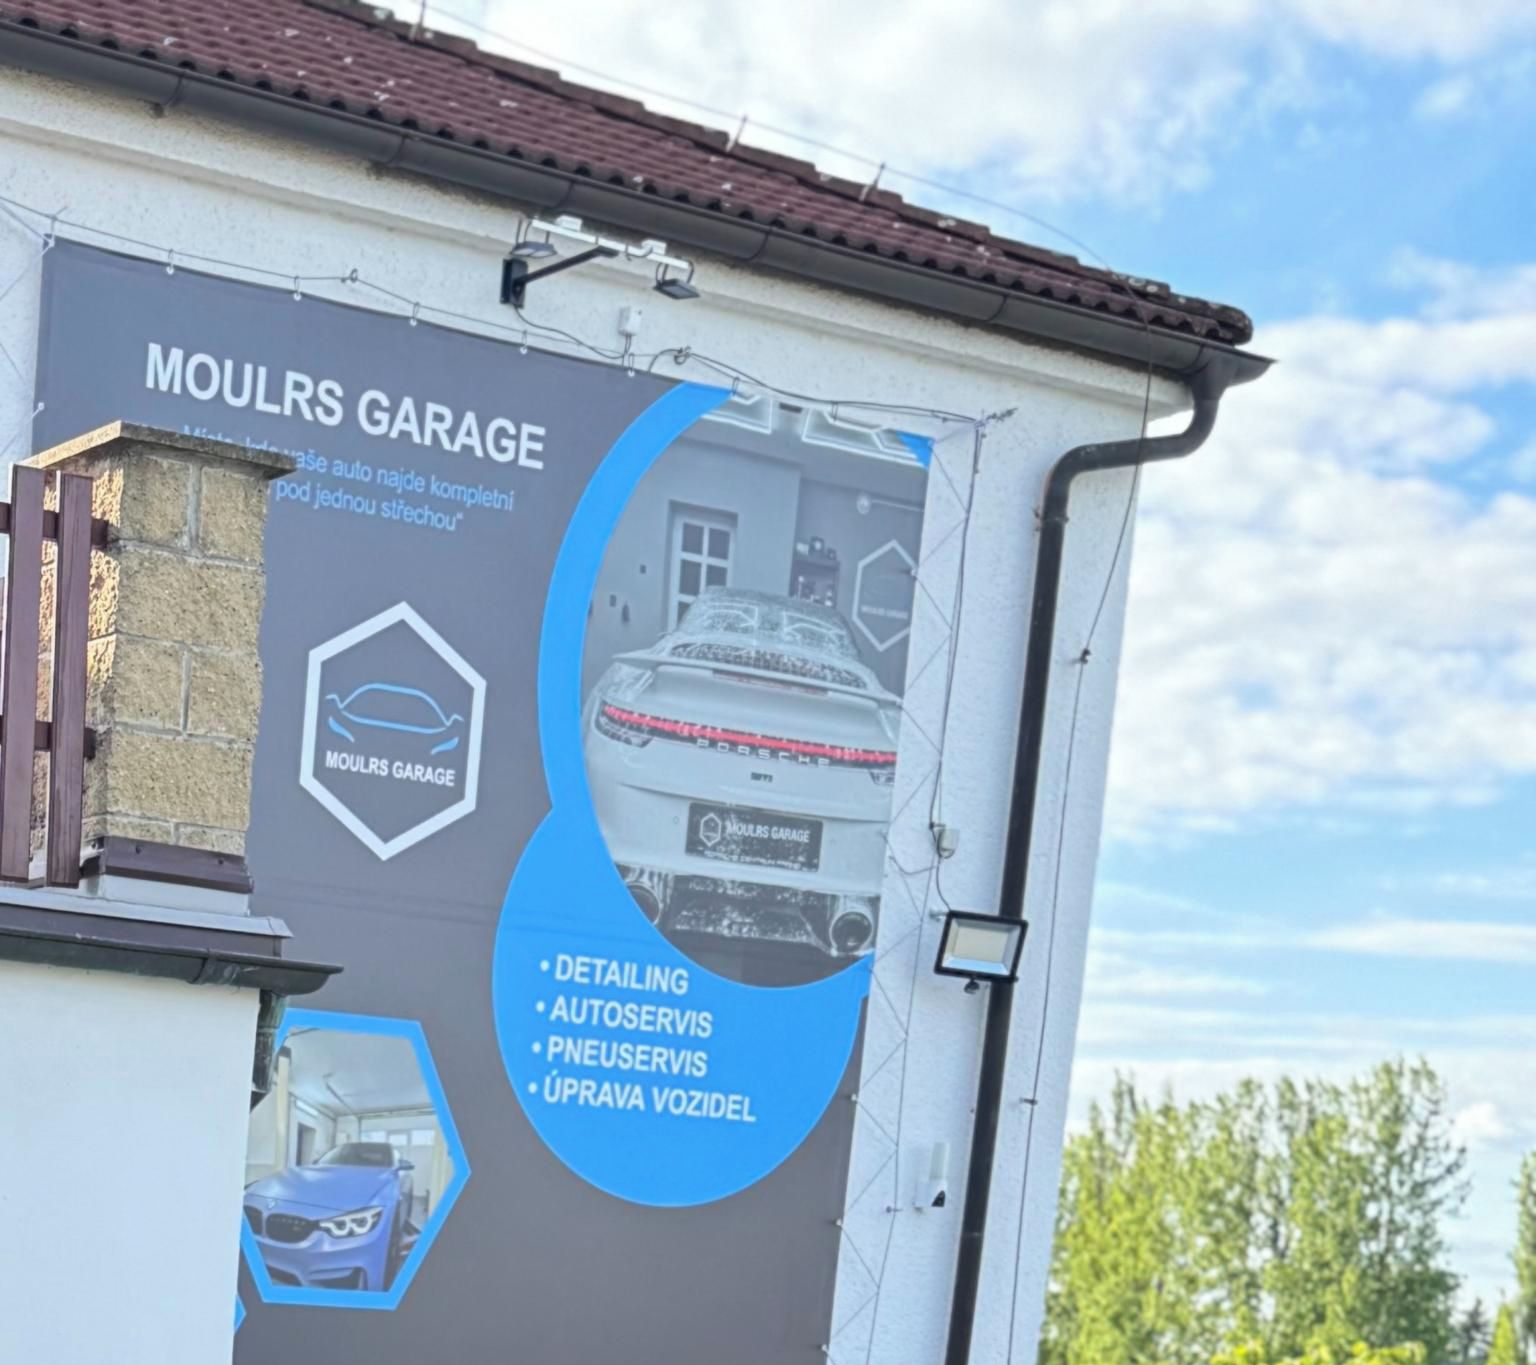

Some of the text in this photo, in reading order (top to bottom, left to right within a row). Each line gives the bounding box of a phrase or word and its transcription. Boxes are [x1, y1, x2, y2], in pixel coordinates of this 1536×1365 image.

[145, 342, 546, 470] MOULRS GARAGE
[275, 478, 310, 502] pod
[313, 483, 376, 516] jednou
[332, 459, 372, 483] auto
[376, 469, 426, 494] najde
[430, 476, 515, 512] kompletní
[325, 750, 456, 787] MOULRS GARAGE
[726, 820, 811, 843] MOULRS GARAGE
[554, 953, 690, 996] DETAILING
[549, 995, 714, 1039] AUTOSERVIS
[547, 1035, 709, 1078] PNEUSERVIS
[543, 1069, 757, 1123] ÚPRAVA VOZIDEL
